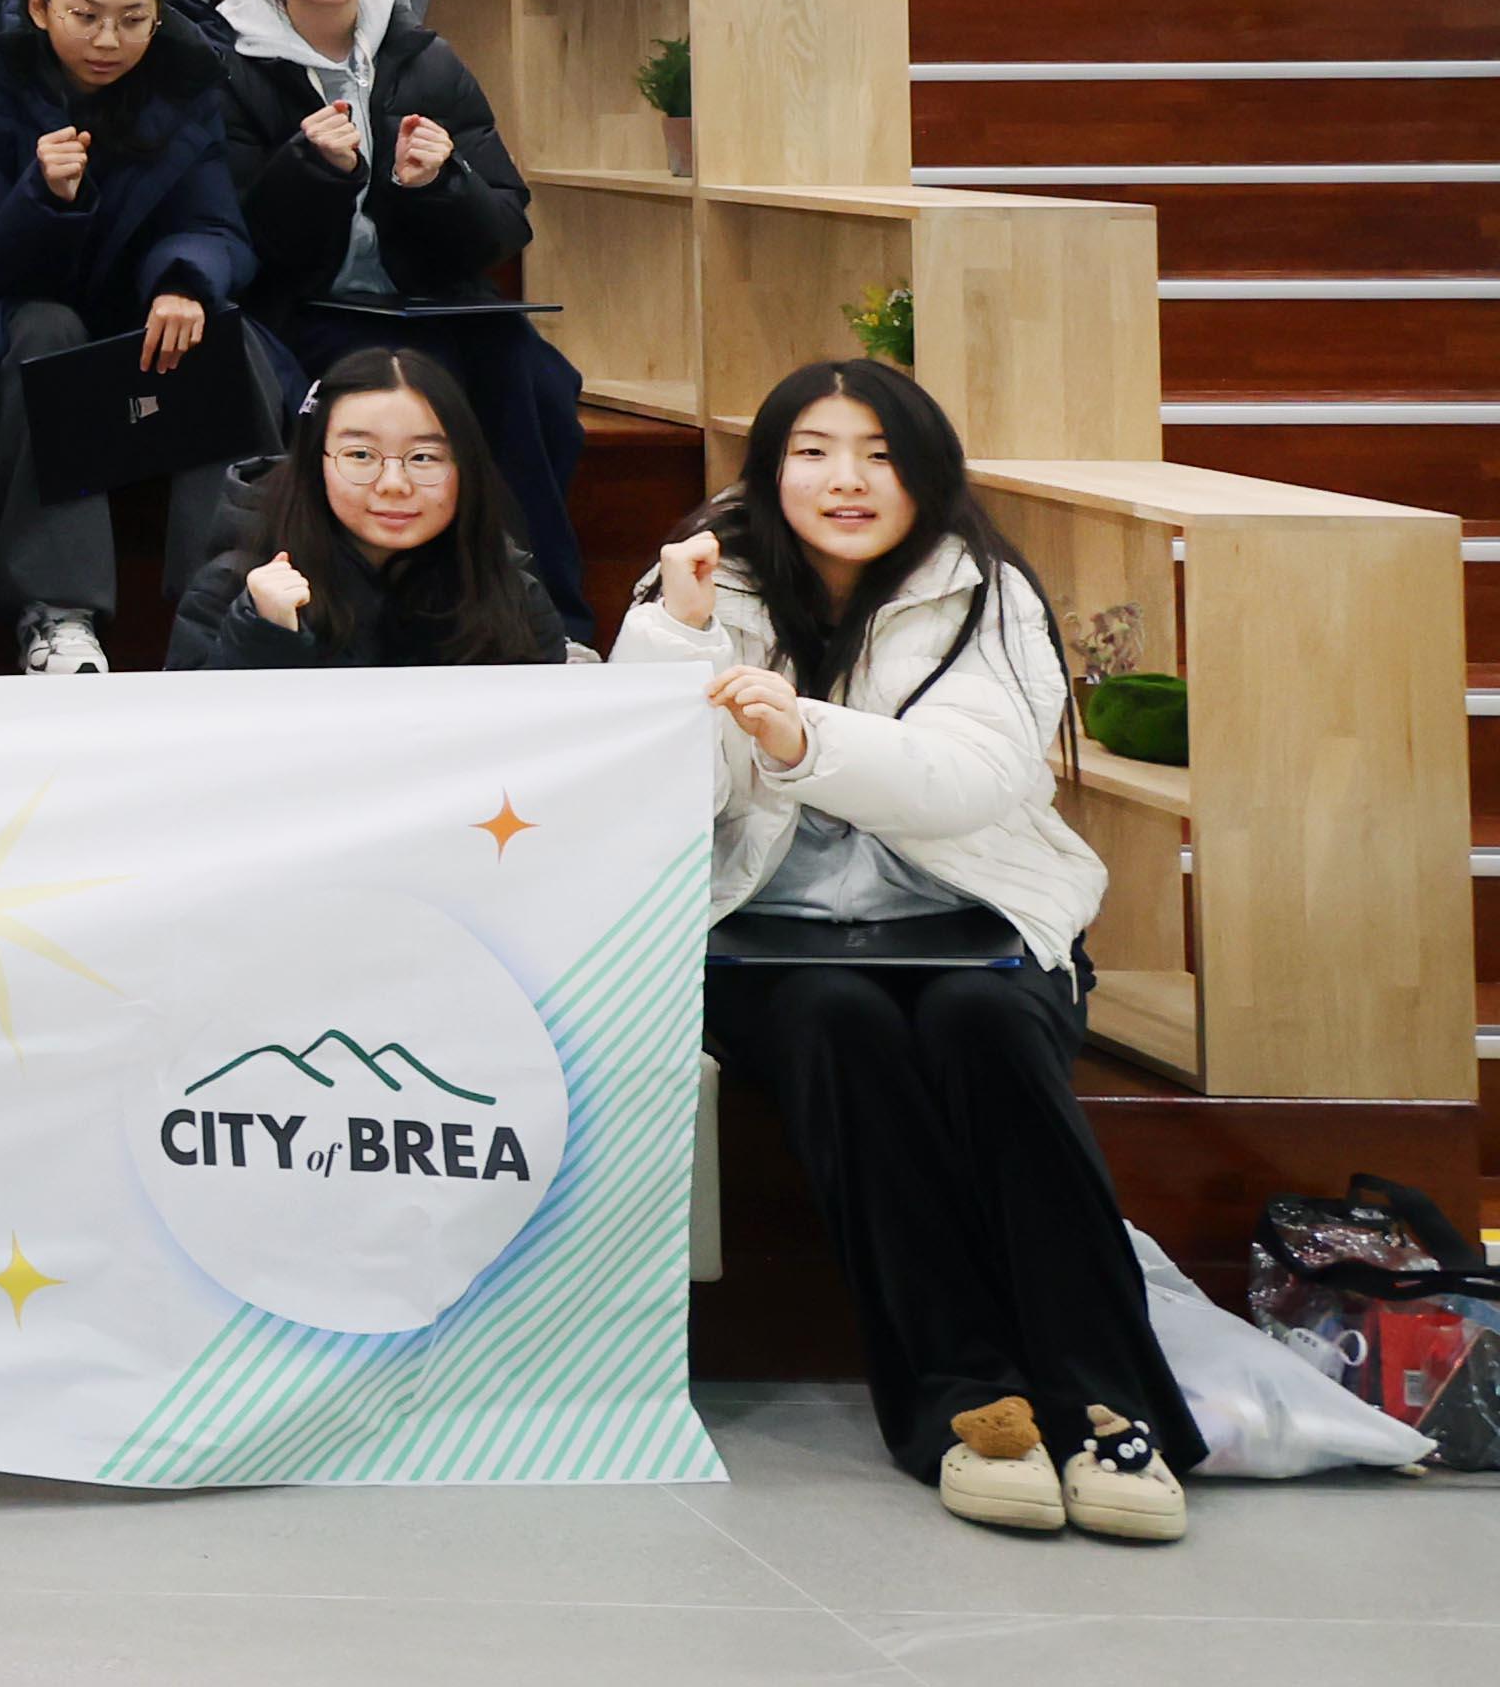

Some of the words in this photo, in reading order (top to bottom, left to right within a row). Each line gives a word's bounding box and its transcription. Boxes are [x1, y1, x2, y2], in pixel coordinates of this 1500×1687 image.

[160, 1108, 307, 1170] CITY
[306, 1143, 344, 1179] of
[348, 1116, 532, 1182] BREA
